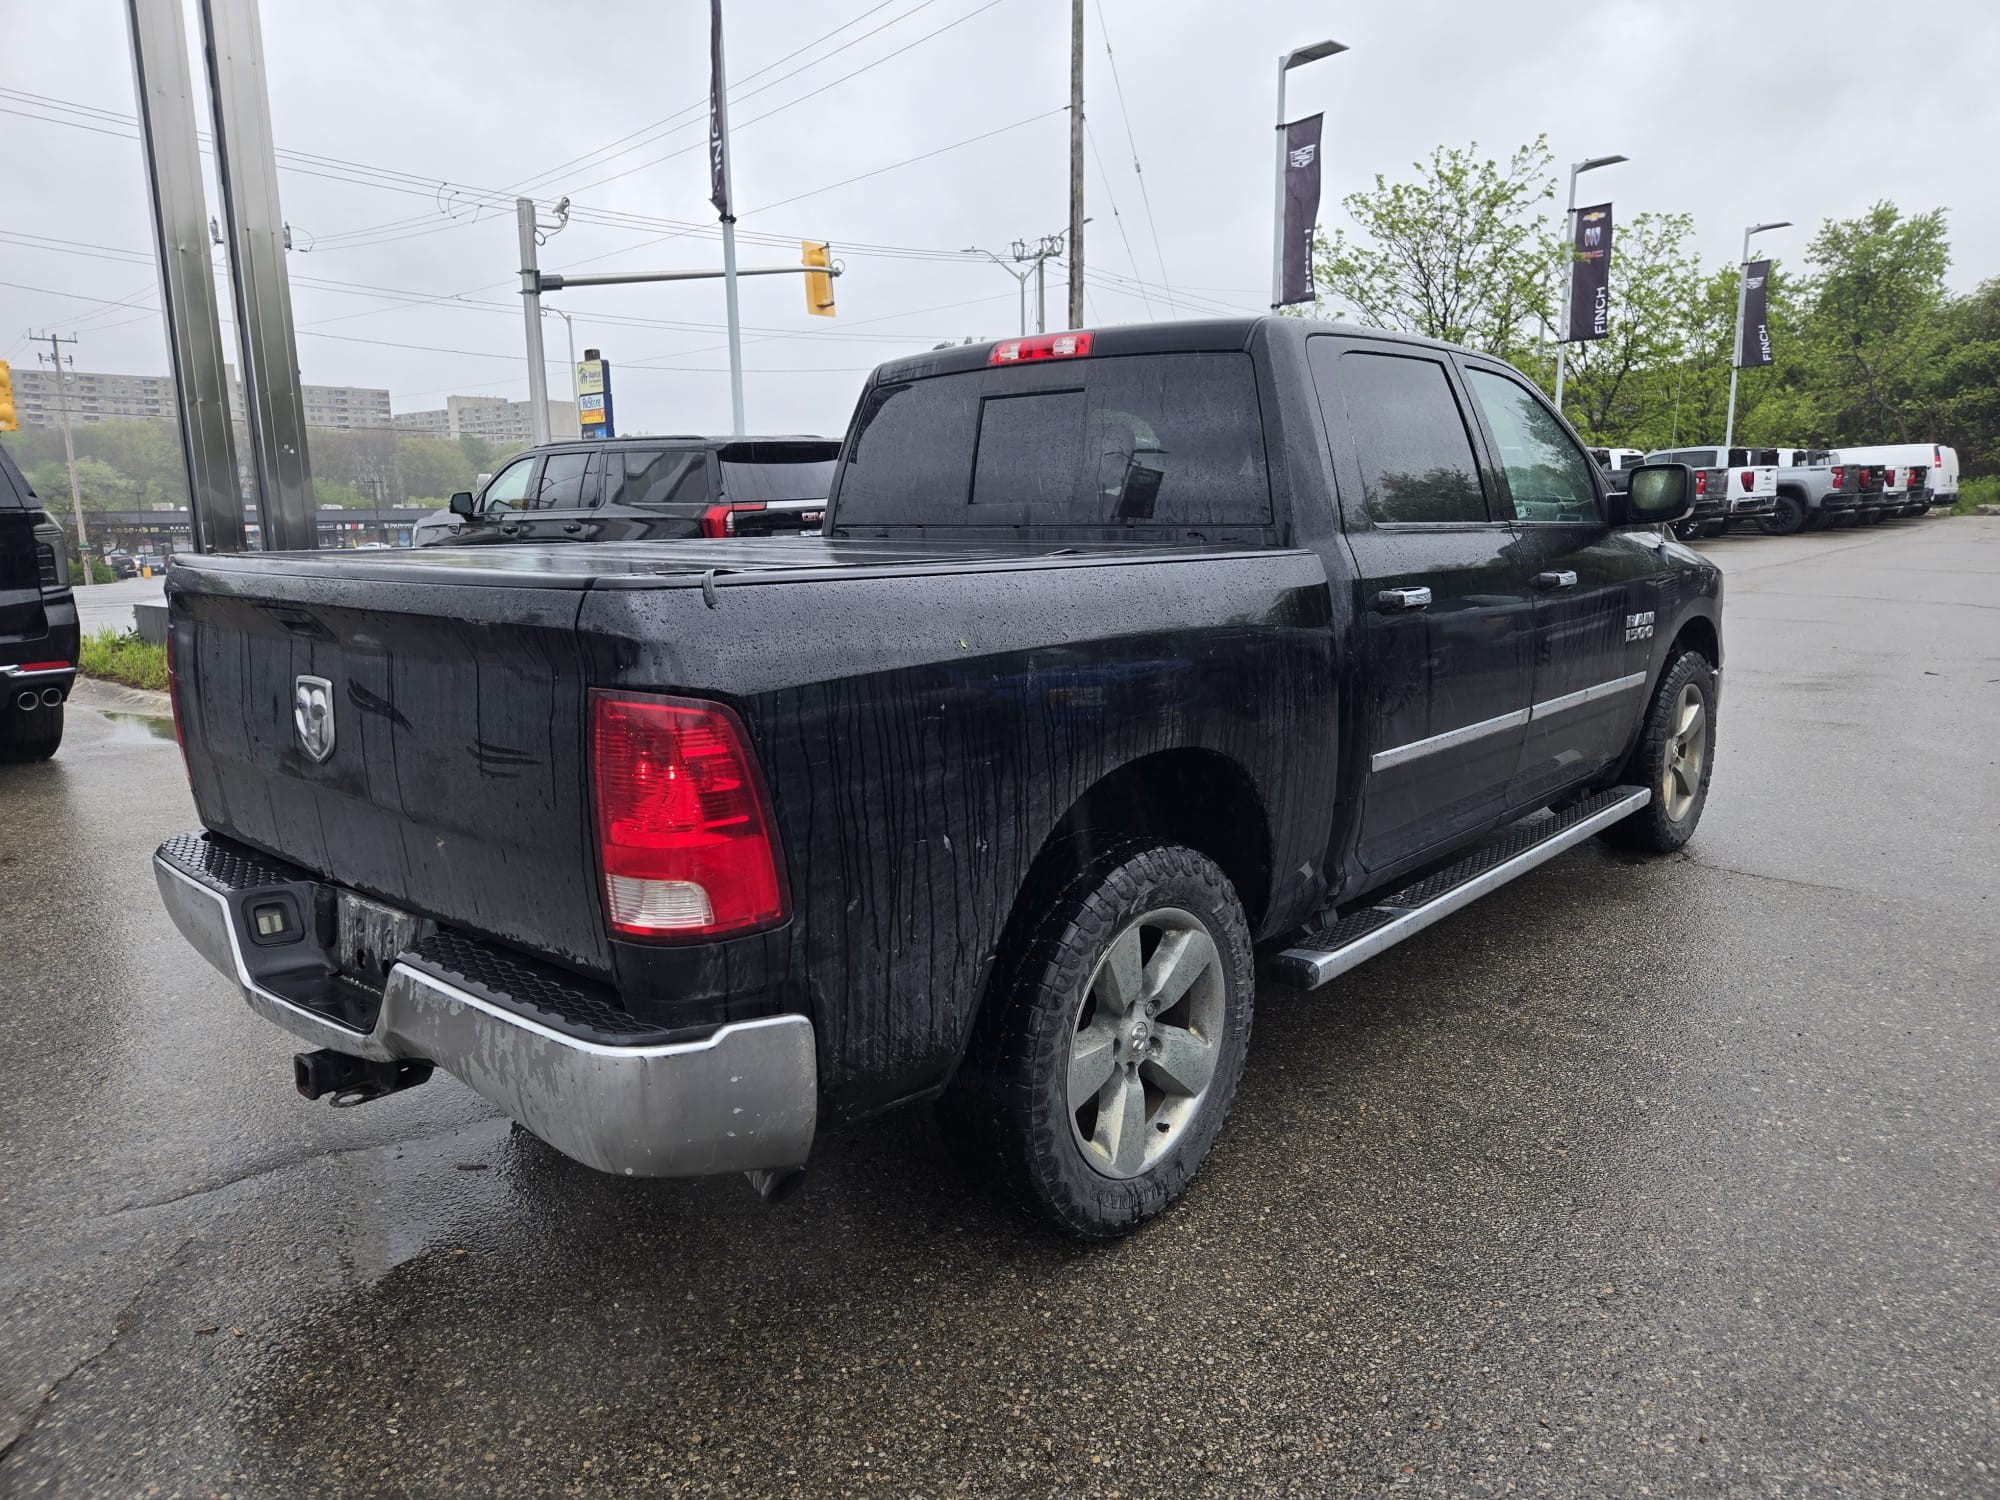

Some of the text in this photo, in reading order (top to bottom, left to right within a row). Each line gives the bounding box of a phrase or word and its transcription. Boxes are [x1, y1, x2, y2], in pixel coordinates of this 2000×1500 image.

[1595, 286, 1606, 334] FINCH
[1758, 324, 1772, 361] FINCH
[1626, 611, 1655, 628] RAM
[1625, 625, 1654, 642] 1500
